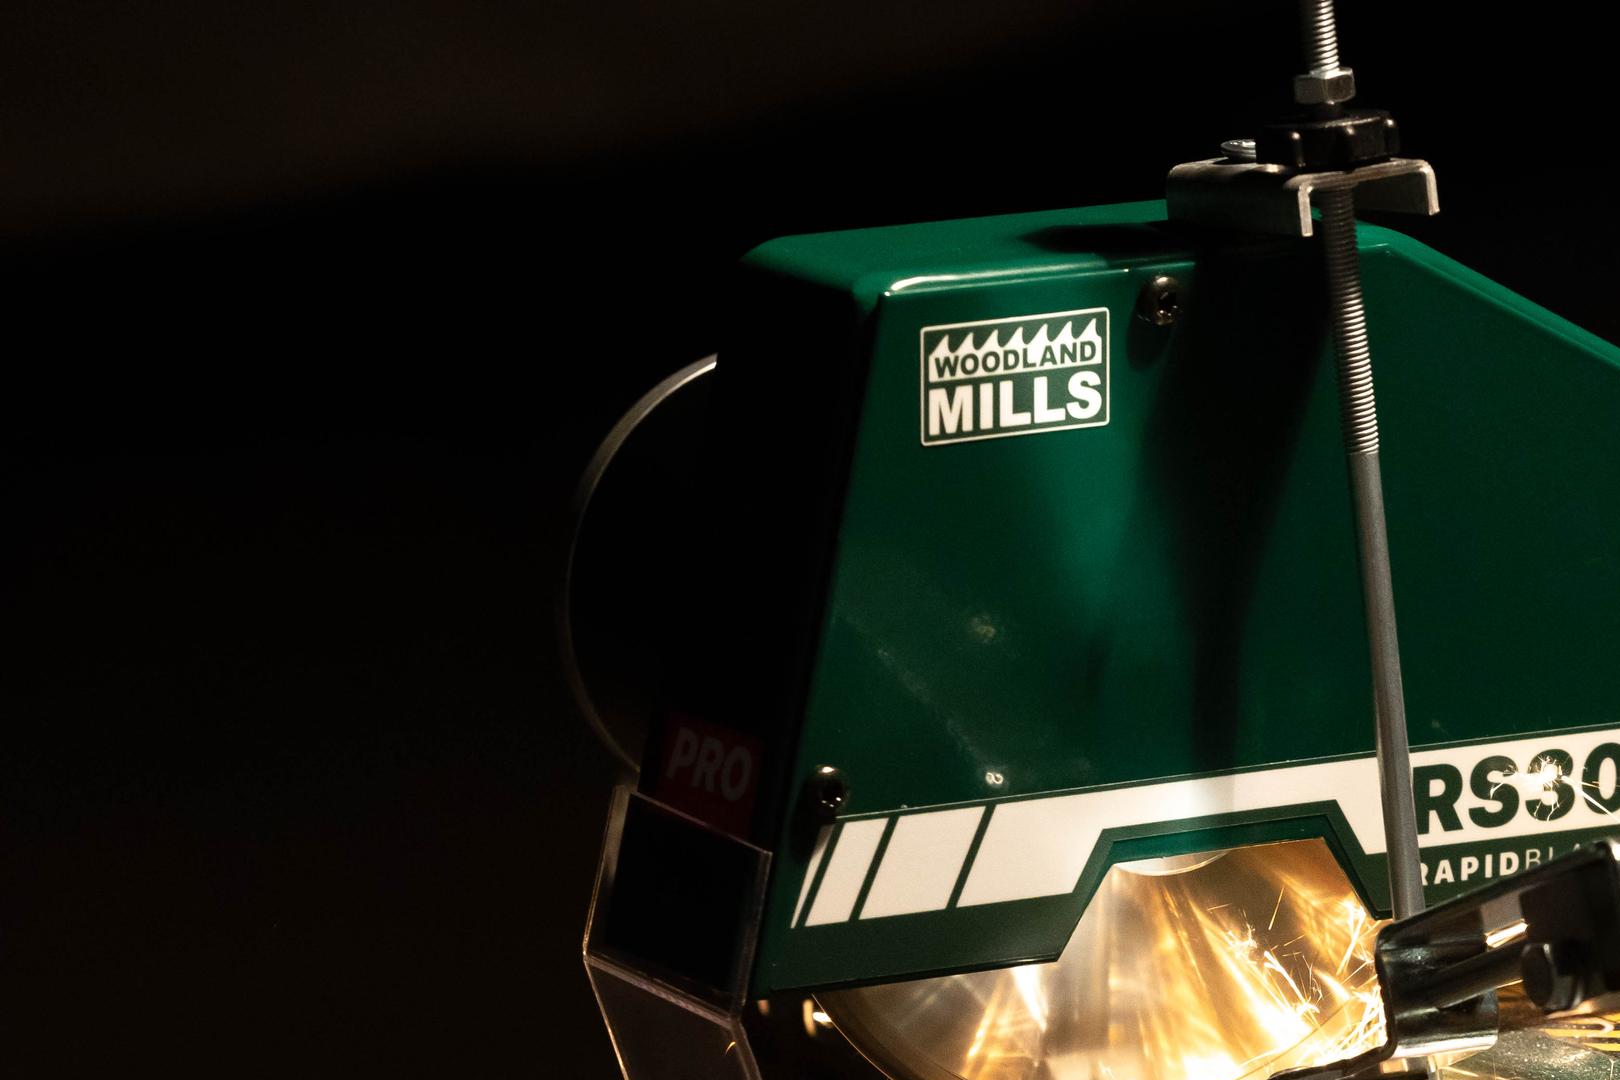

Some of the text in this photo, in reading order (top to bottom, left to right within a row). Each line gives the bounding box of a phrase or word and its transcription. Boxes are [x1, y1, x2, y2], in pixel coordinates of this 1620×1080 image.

[934, 340, 1097, 379] WOODLAND
[928, 370, 1102, 436] MILLS
[665, 725, 752, 802] PRO
